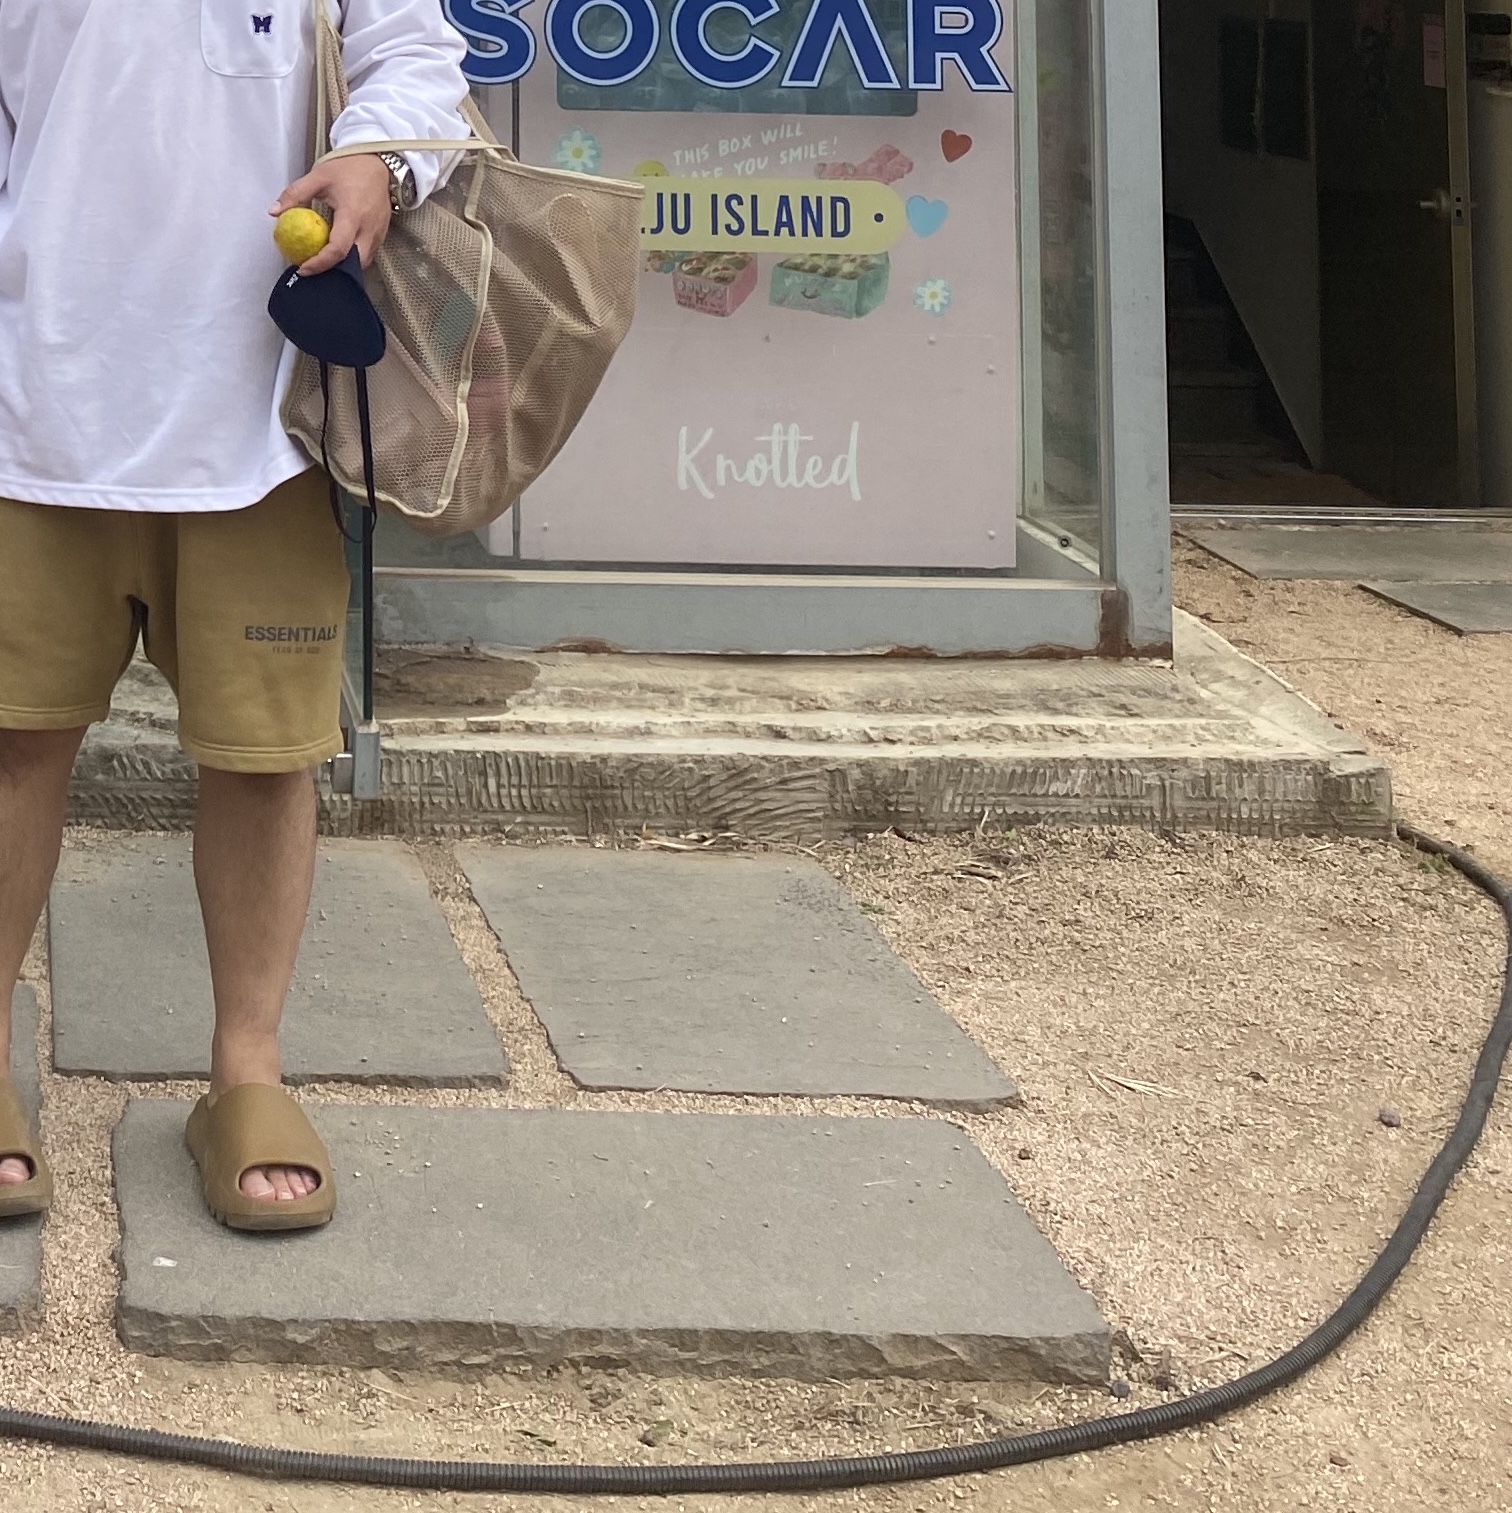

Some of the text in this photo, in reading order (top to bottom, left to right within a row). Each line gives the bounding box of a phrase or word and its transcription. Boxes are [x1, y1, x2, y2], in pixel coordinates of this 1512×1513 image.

[673, 122, 803, 166] THIS BOX WILL
[733, 156, 768, 176] YOU
[779, 136, 838, 164] SMILE!
[640, 193, 852, 238] JU ISLAND
[676, 421, 861, 501] Knotted
